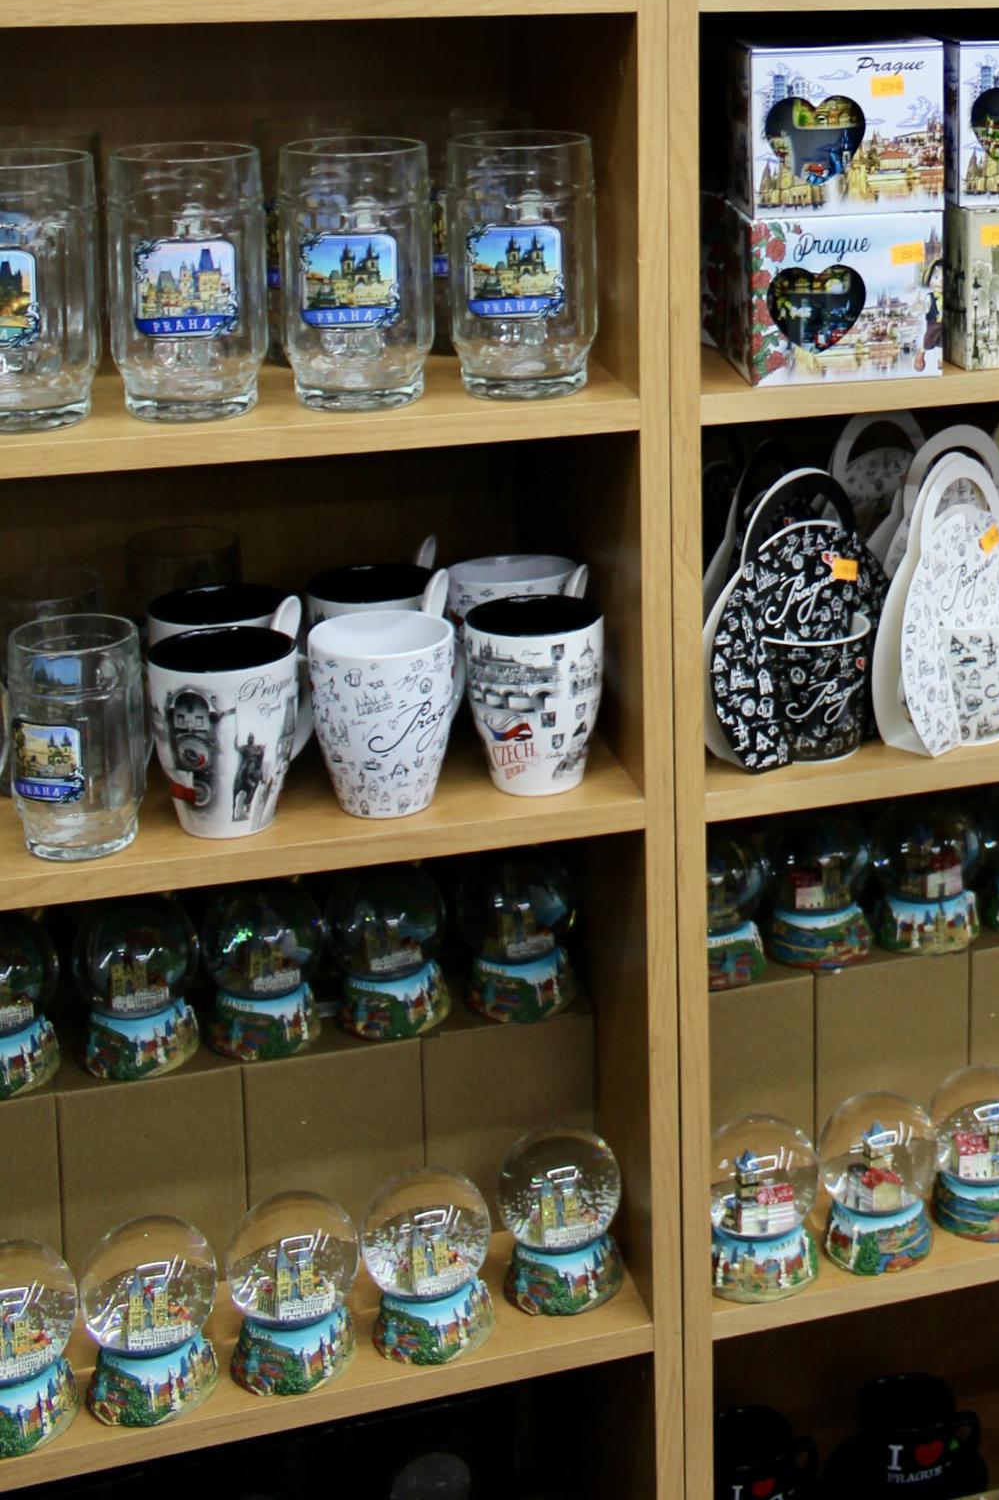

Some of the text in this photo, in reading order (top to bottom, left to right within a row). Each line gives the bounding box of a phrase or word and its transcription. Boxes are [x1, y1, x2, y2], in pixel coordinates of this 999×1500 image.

[856, 56, 926, 75] Prague
[793, 232, 871, 263] Prague
[316, 310, 373, 323] PRAHA
[483, 300, 539, 314] PRAHA
[153, 319, 212, 333] PRAHA
[491, 741, 535, 767] CZECH
[887, 1444, 904, 1472] I
[886, 1463, 943, 1484] PRAGUE
